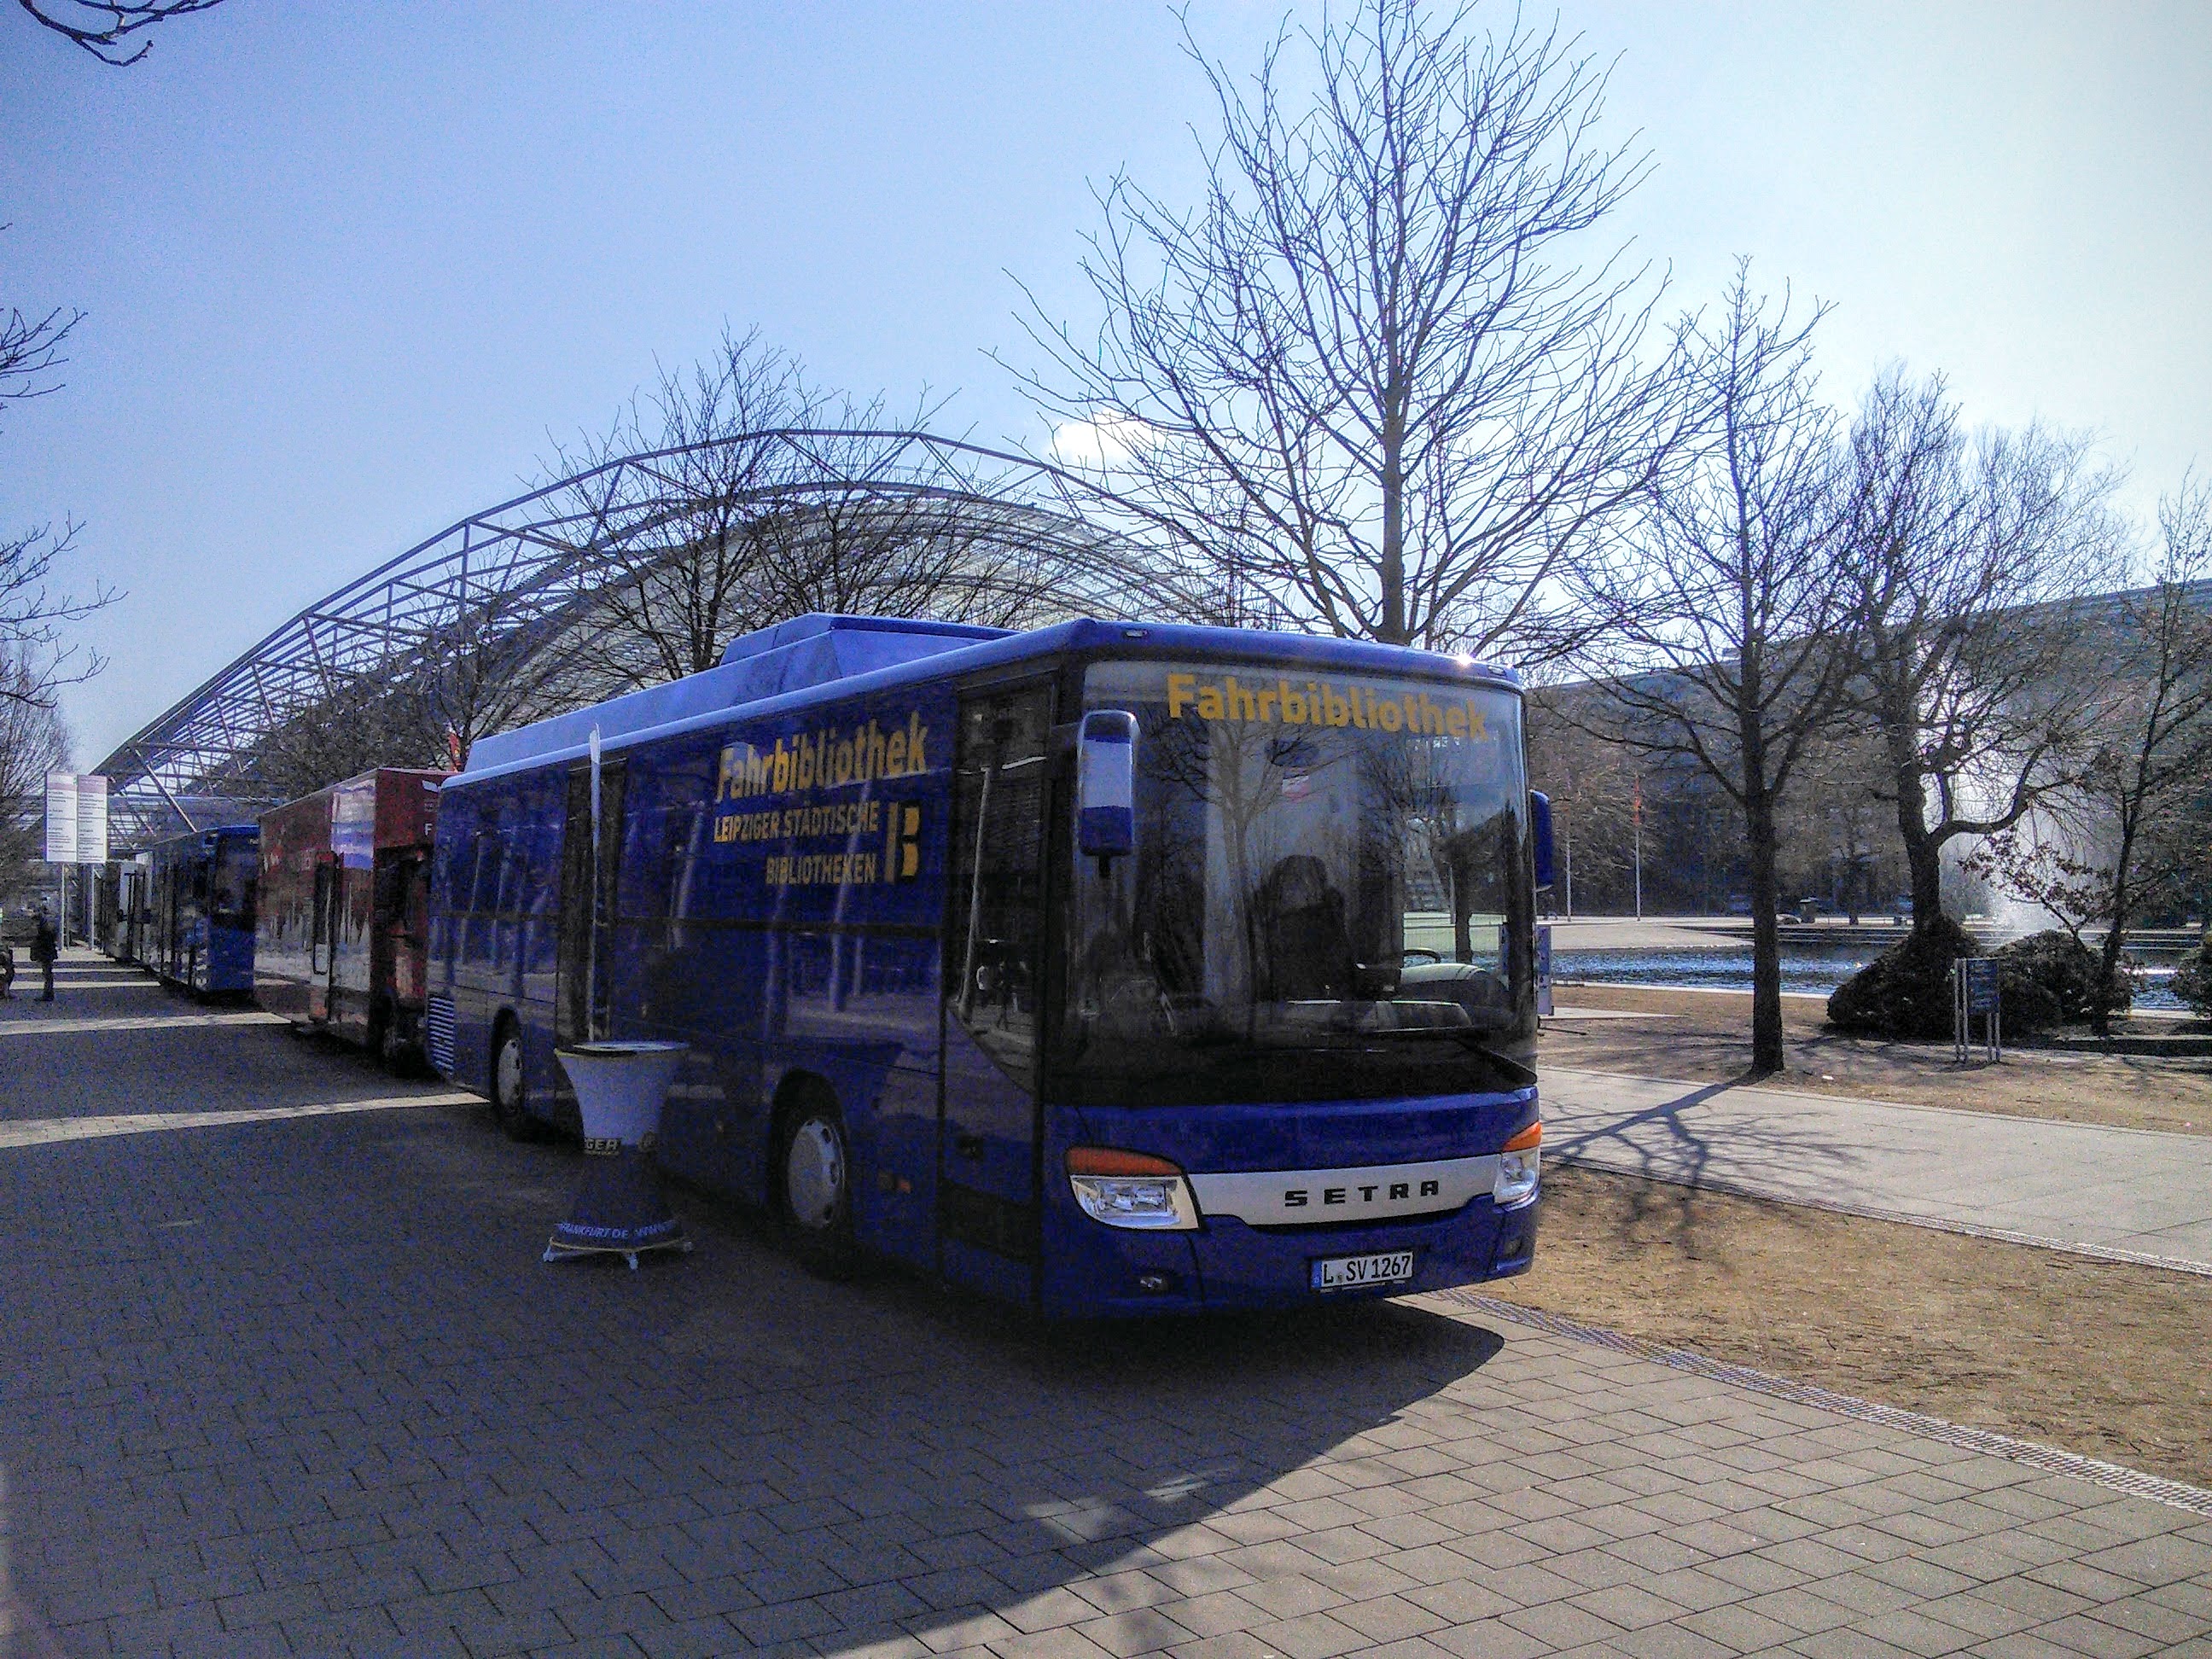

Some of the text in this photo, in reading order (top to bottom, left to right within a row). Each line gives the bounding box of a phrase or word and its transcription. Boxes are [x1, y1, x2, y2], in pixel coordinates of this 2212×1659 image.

[1167, 672, 1488, 742] Fahrbibliothek
[718, 710, 928, 803] Fahrbibliothek
[713, 800, 880, 843] LEIPZIGER STÄDTISCHE
[765, 853, 876, 884] BIBLIOTHEKEN
[1284, 1180, 1439, 1207] SETRA
[1324, 1264, 1334, 1284] L
[1346, 1260, 1367, 1282] SV
[1371, 1255, 1411, 1278] 1267
